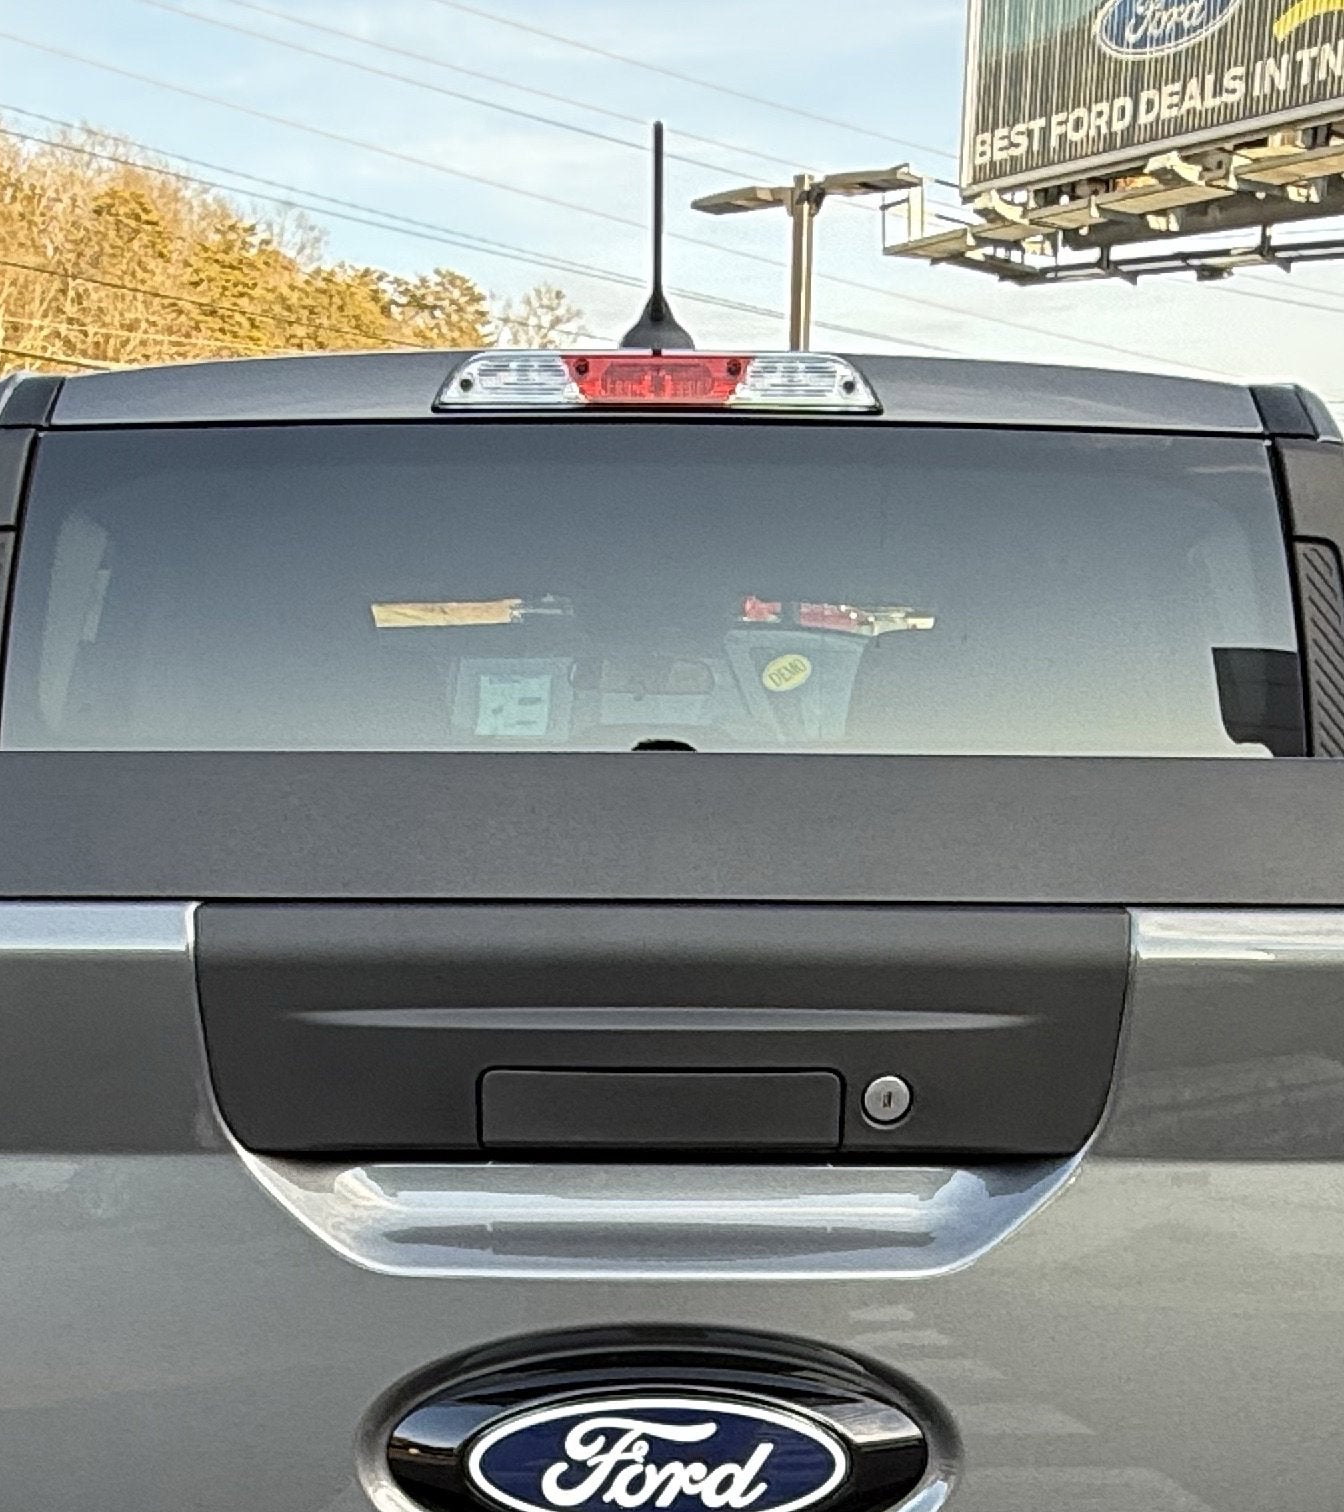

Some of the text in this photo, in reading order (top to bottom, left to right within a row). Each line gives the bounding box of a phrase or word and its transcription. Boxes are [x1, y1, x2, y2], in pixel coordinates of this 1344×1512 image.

[973, 118, 1046, 166] BEST
[1051, 96, 1133, 148] FORD
[1139, 65, 1246, 125] DEALS
[1253, 54, 1291, 97] IN
[768, 658, 808, 688] DEMO
[541, 1416, 775, 1511] Ford
